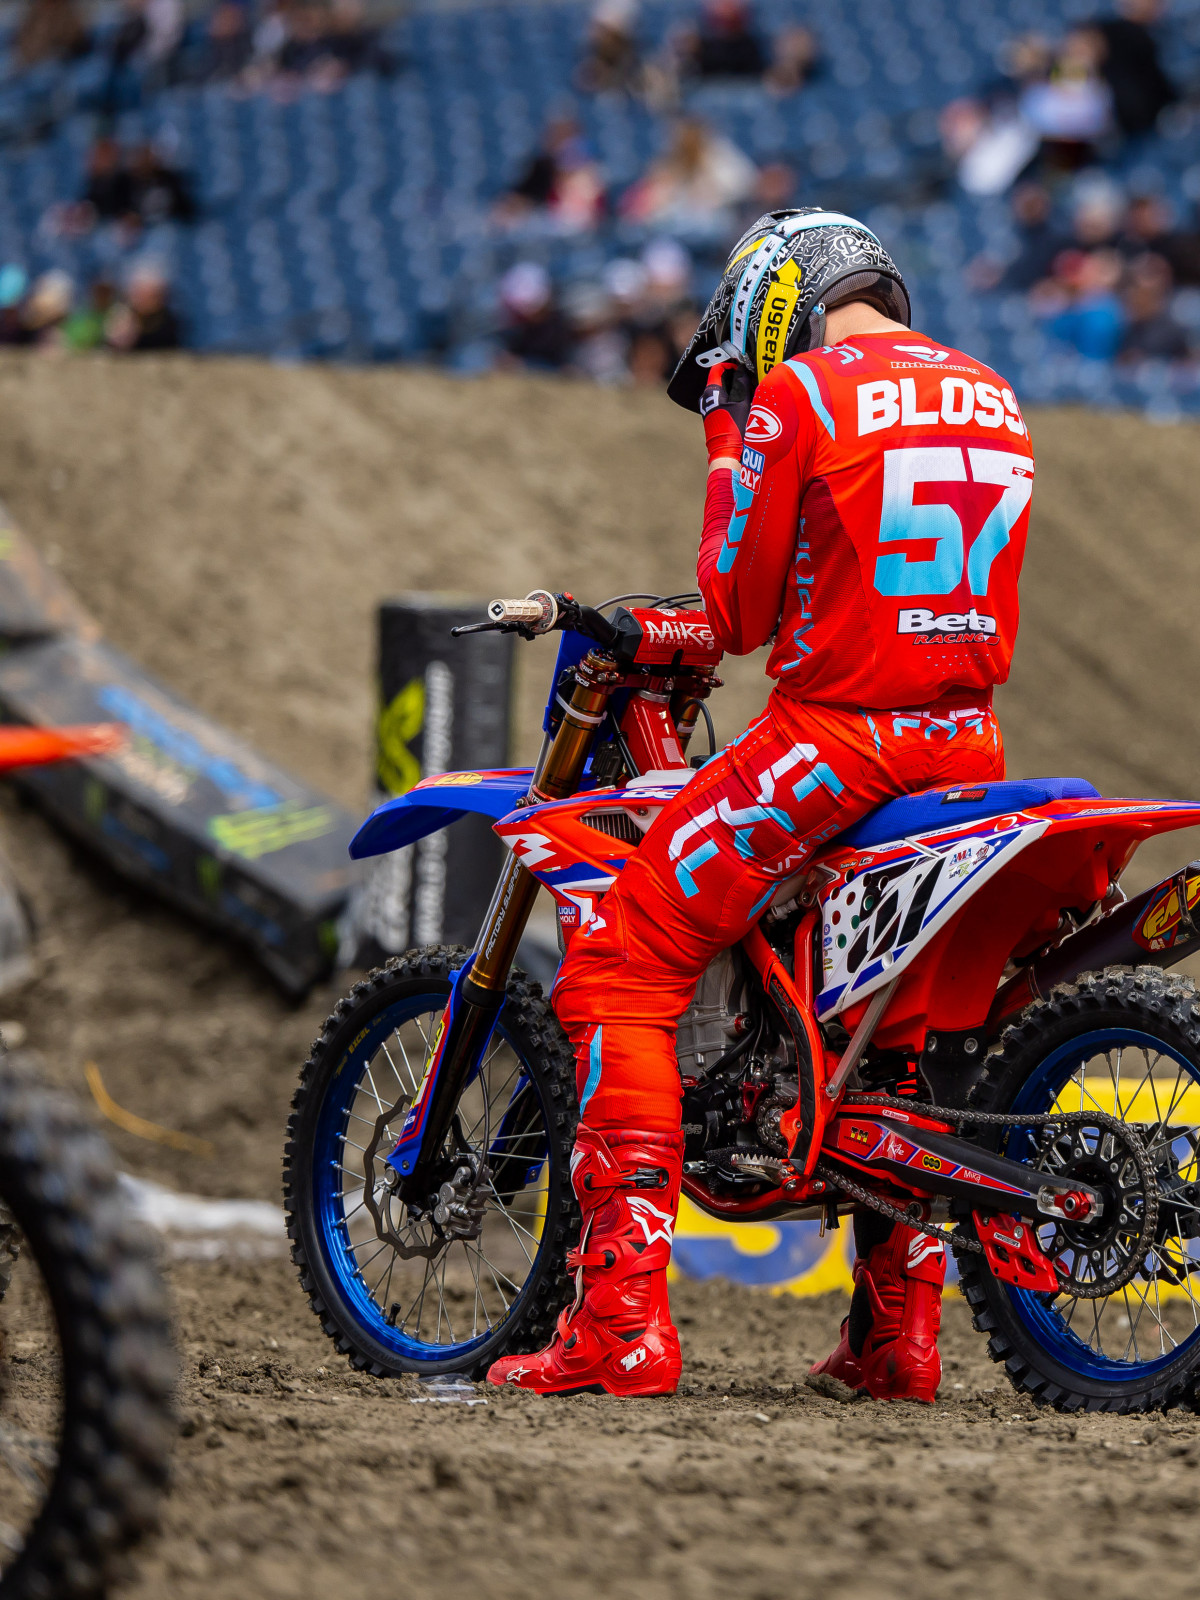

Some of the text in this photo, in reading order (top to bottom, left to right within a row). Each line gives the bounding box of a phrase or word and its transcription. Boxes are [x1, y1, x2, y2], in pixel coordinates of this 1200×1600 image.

[763, 297, 788, 375] sta360
[857, 377, 1026, 437] BLOSS
[742, 448, 764, 472] QUI
[739, 467, 761, 490] OLY
[873, 446, 1035, 597] 57
[898, 608, 997, 634] Beta
[913, 633, 986, 645] RACING
[951, 848, 972, 864] AMA
[485, 859, 523, 960] FACTORY SUSPEN
[851, 1127, 869, 1143] TM
[887, 1140, 905, 1156] Kite
